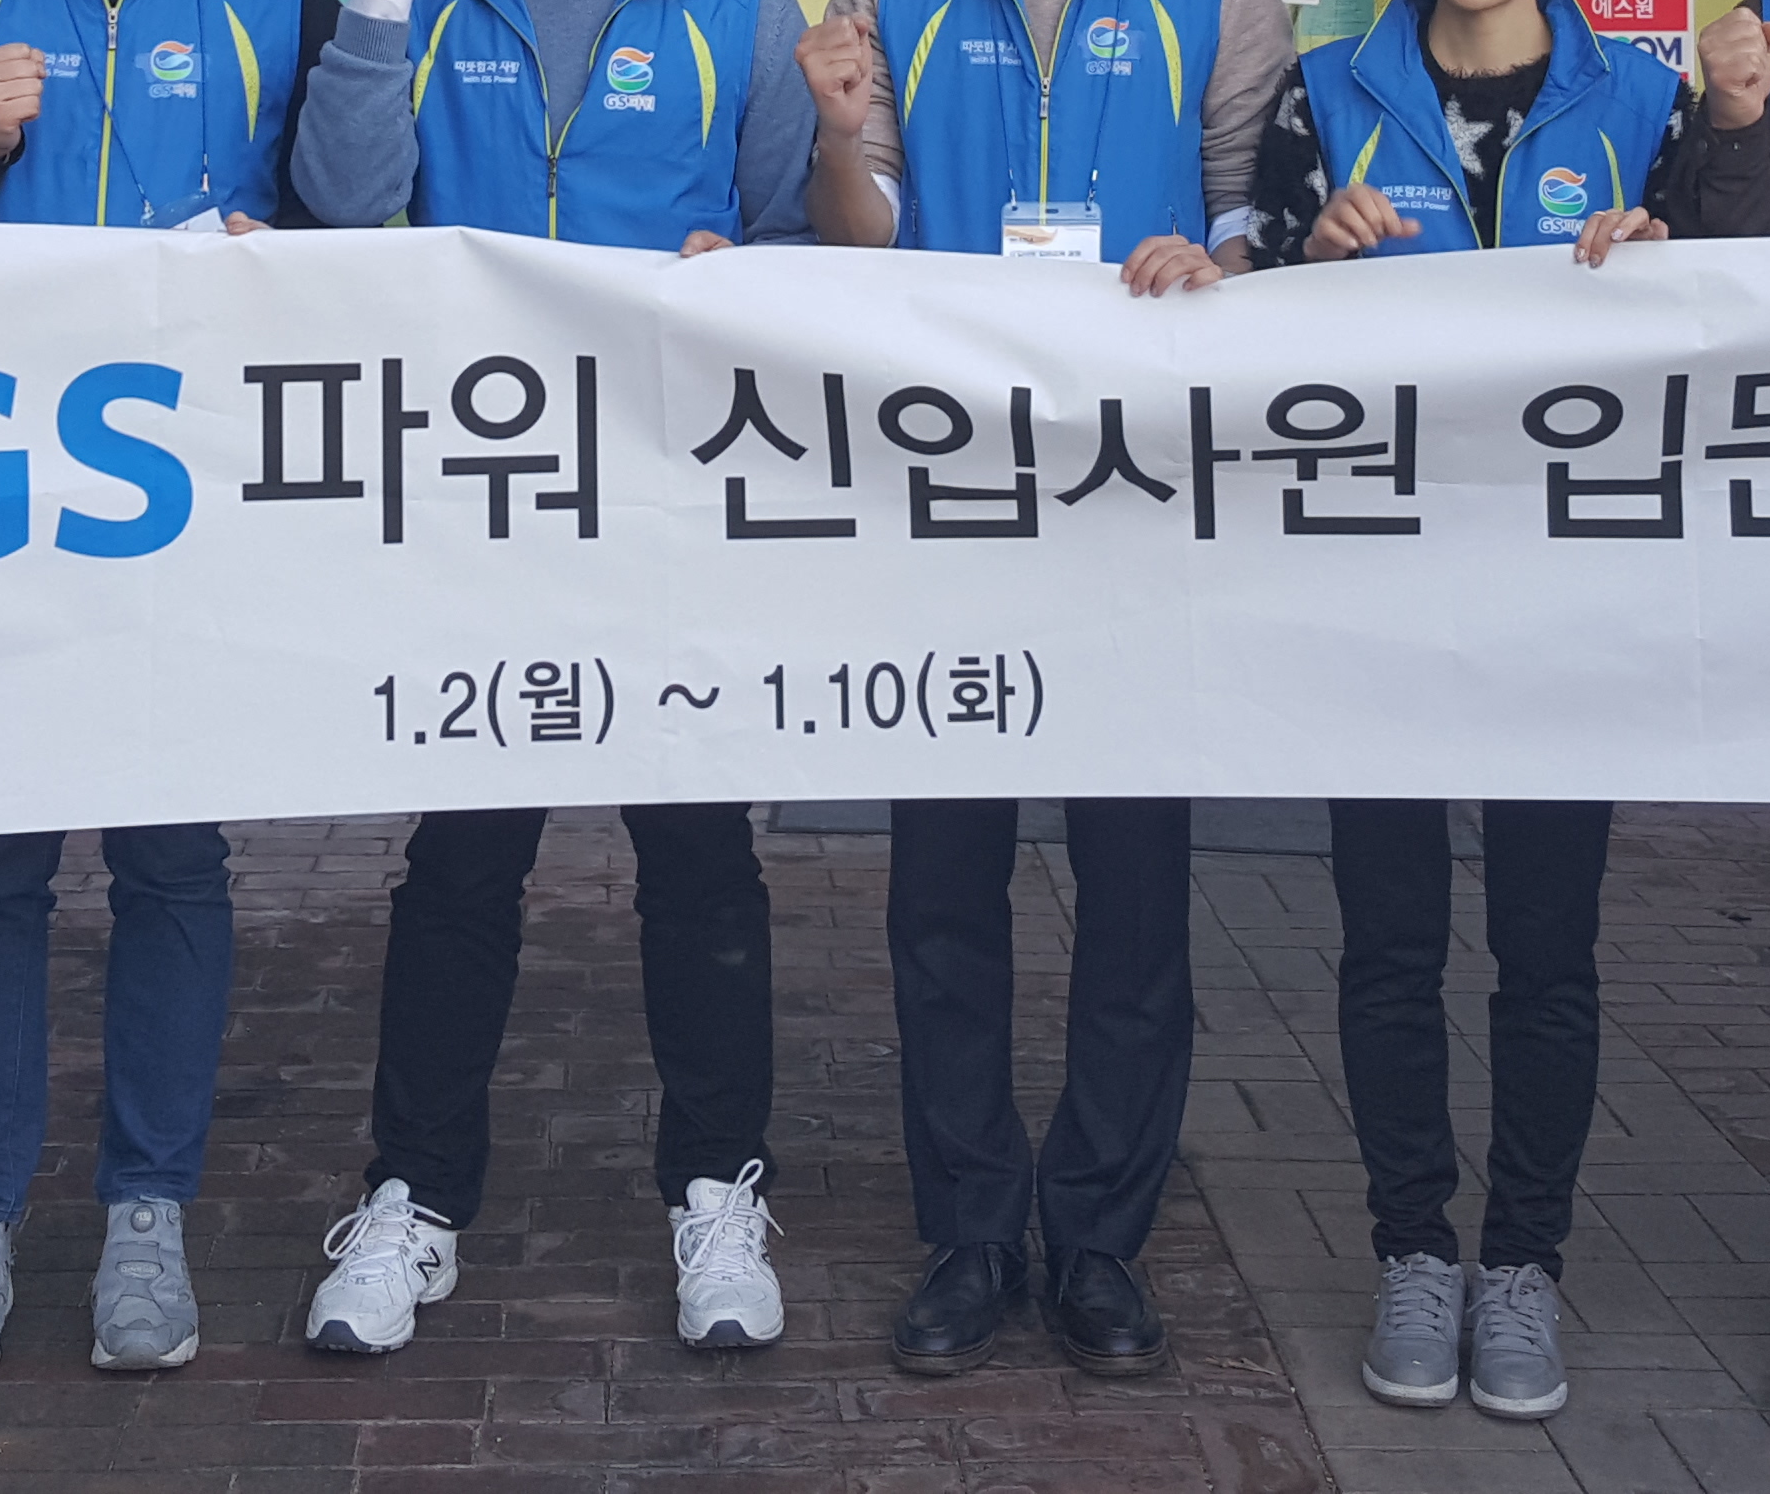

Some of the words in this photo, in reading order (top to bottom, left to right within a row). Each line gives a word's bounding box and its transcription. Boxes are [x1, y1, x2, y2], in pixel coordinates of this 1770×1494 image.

[240, 353, 601, 545] 파워
[689, 366, 1423, 541] 신입사원
[372, 656, 616, 747] 1.2(월)
[762, 647, 1045, 738] 1.10(화)
